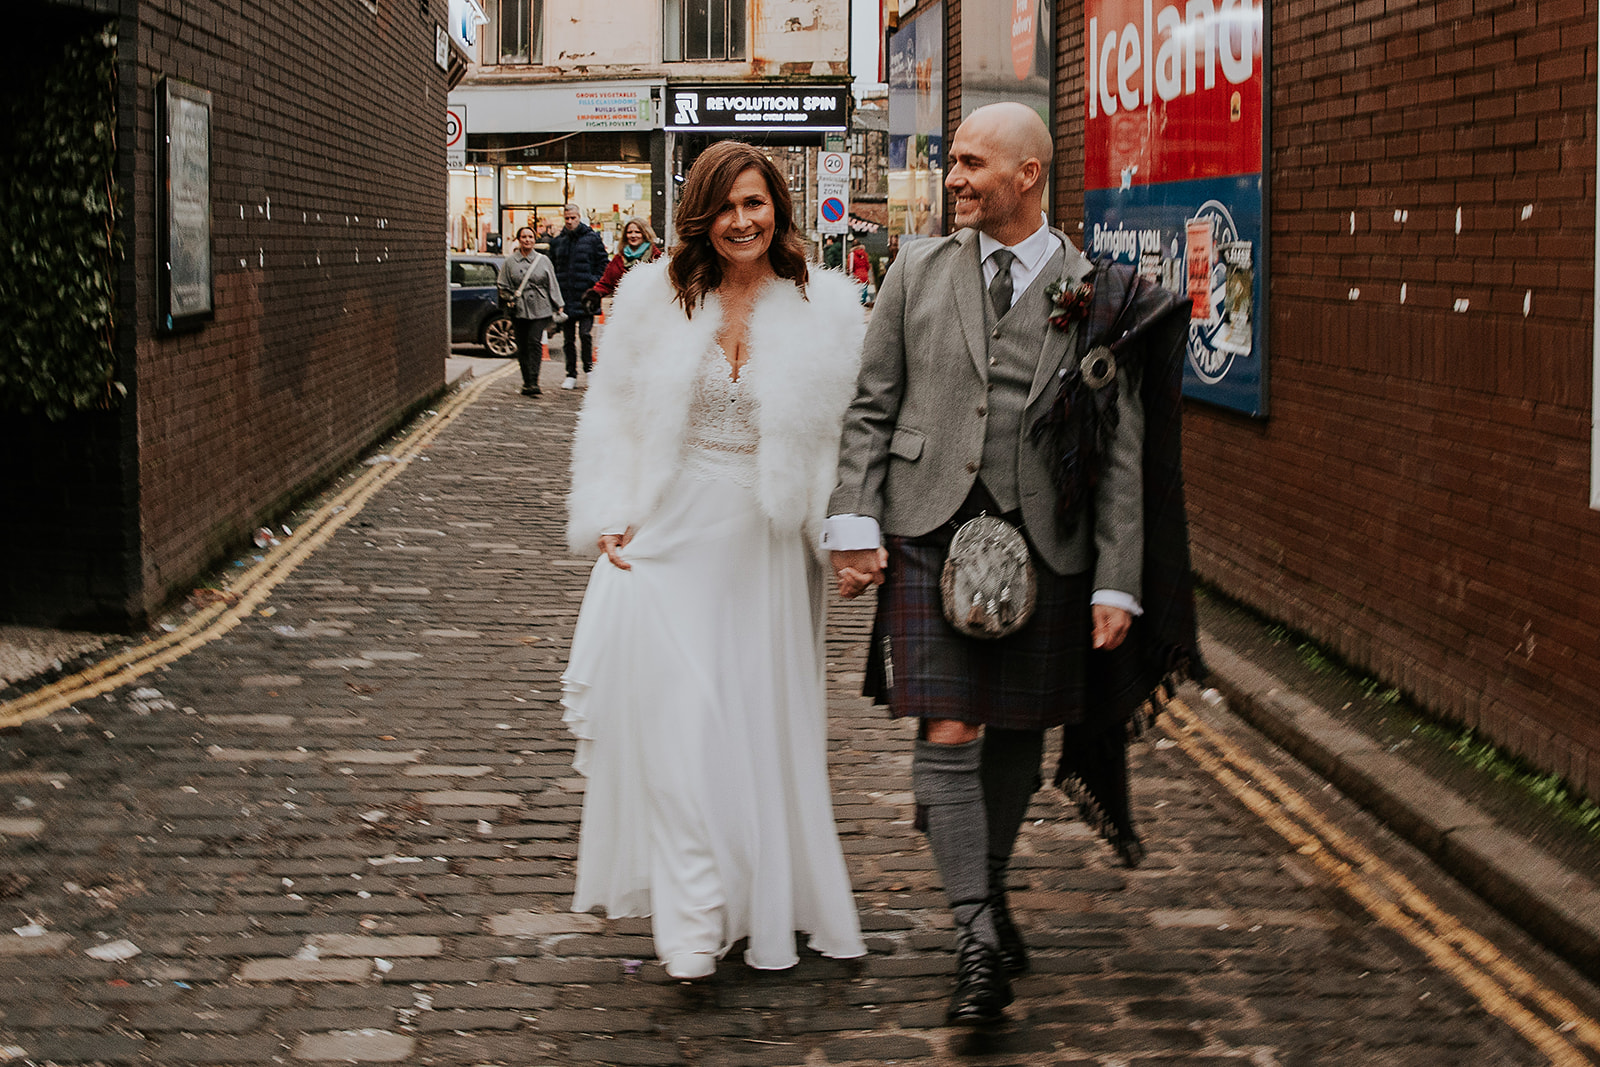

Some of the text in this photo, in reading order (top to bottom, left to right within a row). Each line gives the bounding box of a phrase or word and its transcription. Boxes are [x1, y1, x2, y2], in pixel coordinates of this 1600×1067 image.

[1012, 15, 1032, 38] delivery
[1089, 0, 1253, 119] Iceland
[706, 96, 836, 111] REVOLUTION SPIN
[447, 121, 457, 136] 0
[523, 149, 539, 157] 231
[827, 159, 841, 168] 20
[1093, 222, 1161, 262] Bringing you
